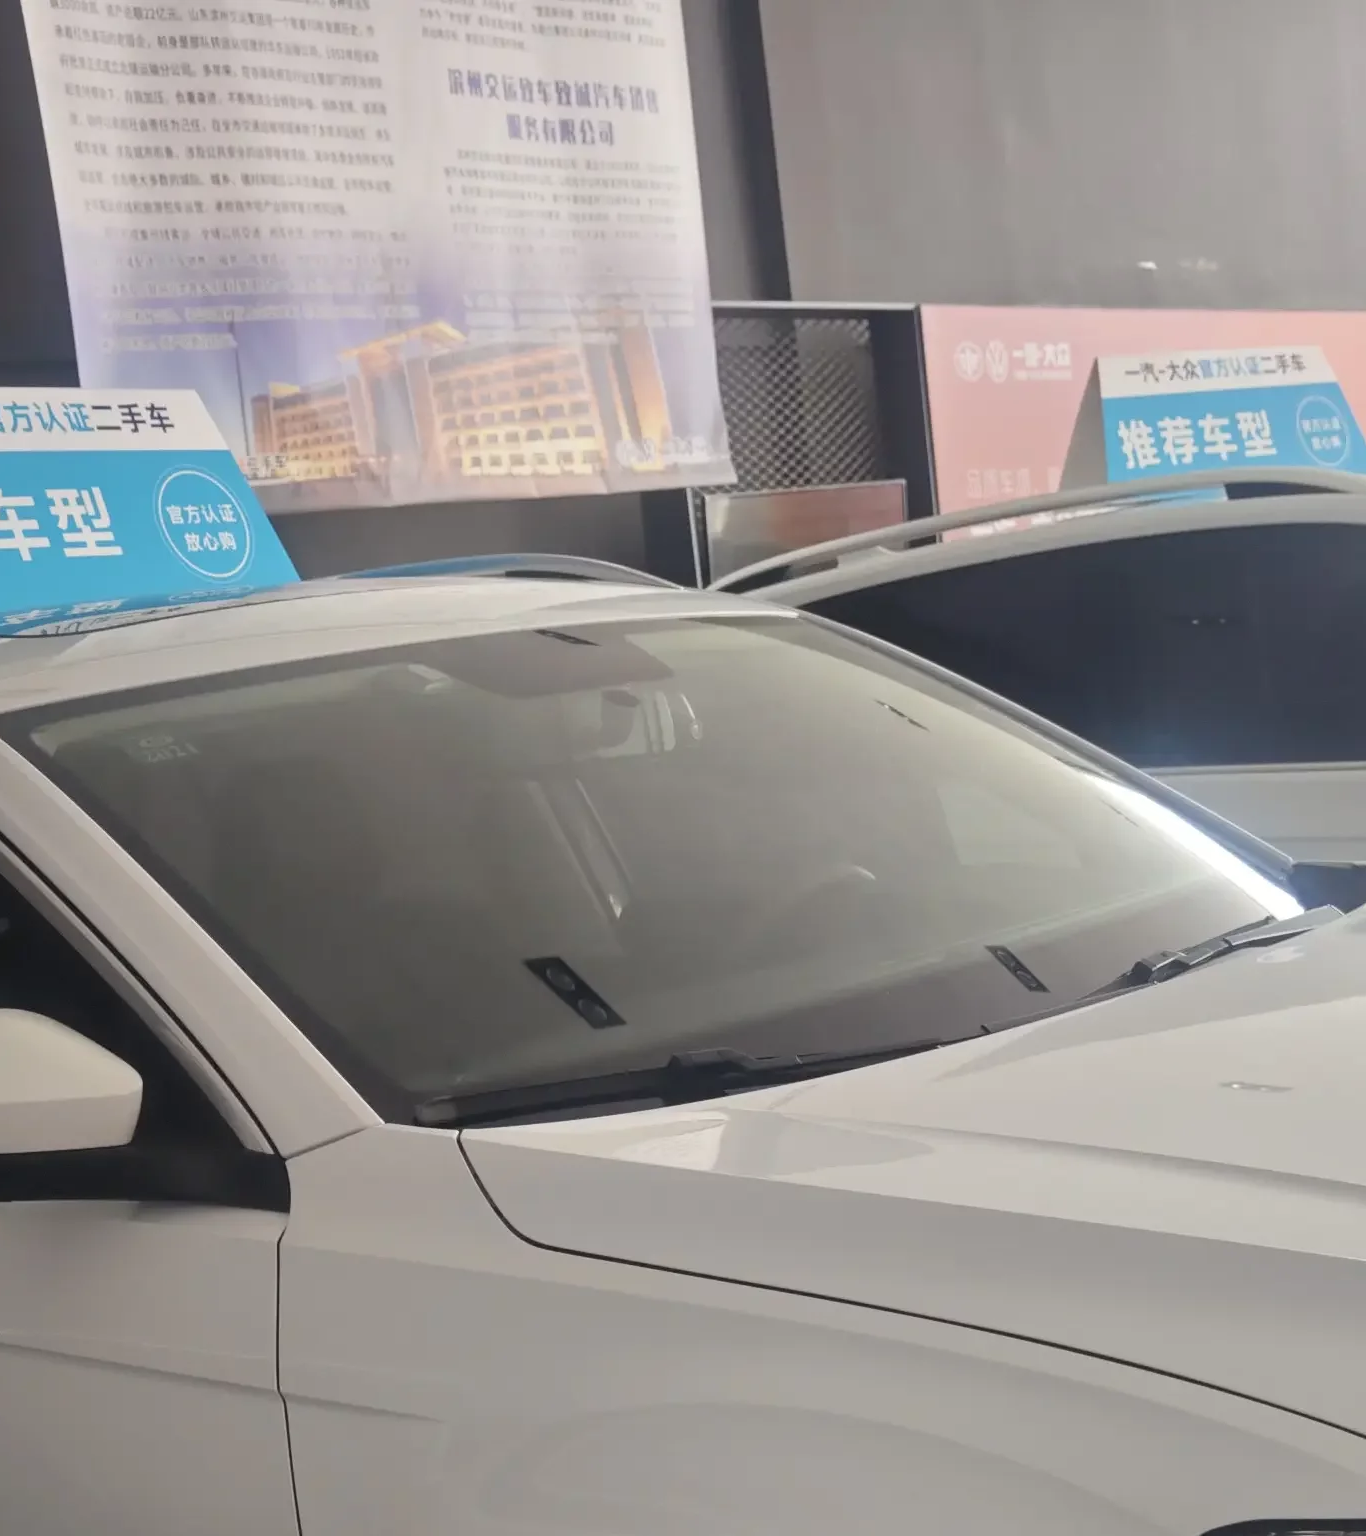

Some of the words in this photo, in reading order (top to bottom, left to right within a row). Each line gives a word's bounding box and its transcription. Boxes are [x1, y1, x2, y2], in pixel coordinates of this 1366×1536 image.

[1117, 408, 1278, 470] 推荐车型
[165, 503, 238, 525] 官方认证
[183, 531, 237, 552] 放心购
